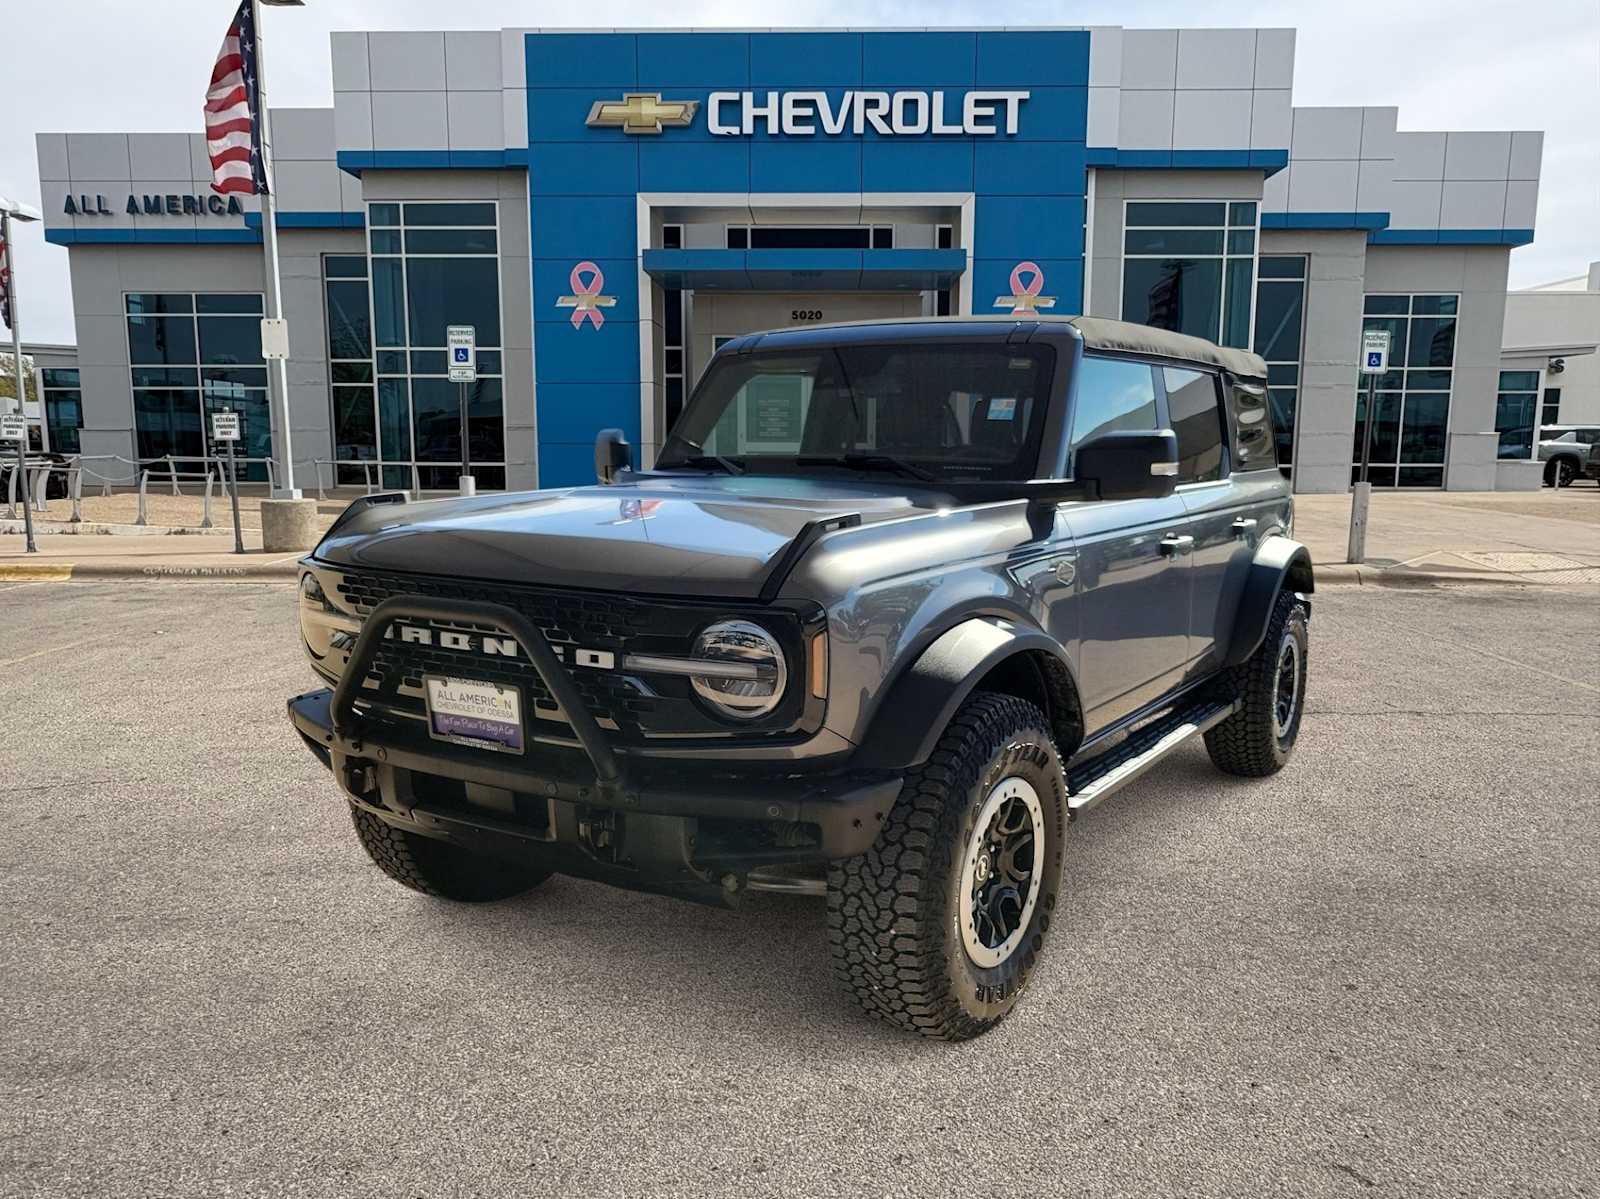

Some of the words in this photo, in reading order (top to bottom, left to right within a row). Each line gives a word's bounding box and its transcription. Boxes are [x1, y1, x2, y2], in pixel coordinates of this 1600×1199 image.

[708, 91, 1030, 135] CHEVROLET
[64, 194, 112, 215] ALL
[126, 194, 243, 215] AMERICA
[791, 310, 823, 320] 5020
[438, 690, 457, 702] ALL
[436, 700, 475, 713] CHEVROLET
[477, 706, 487, 714] OF
[487, 707, 515, 719] ODESSA
